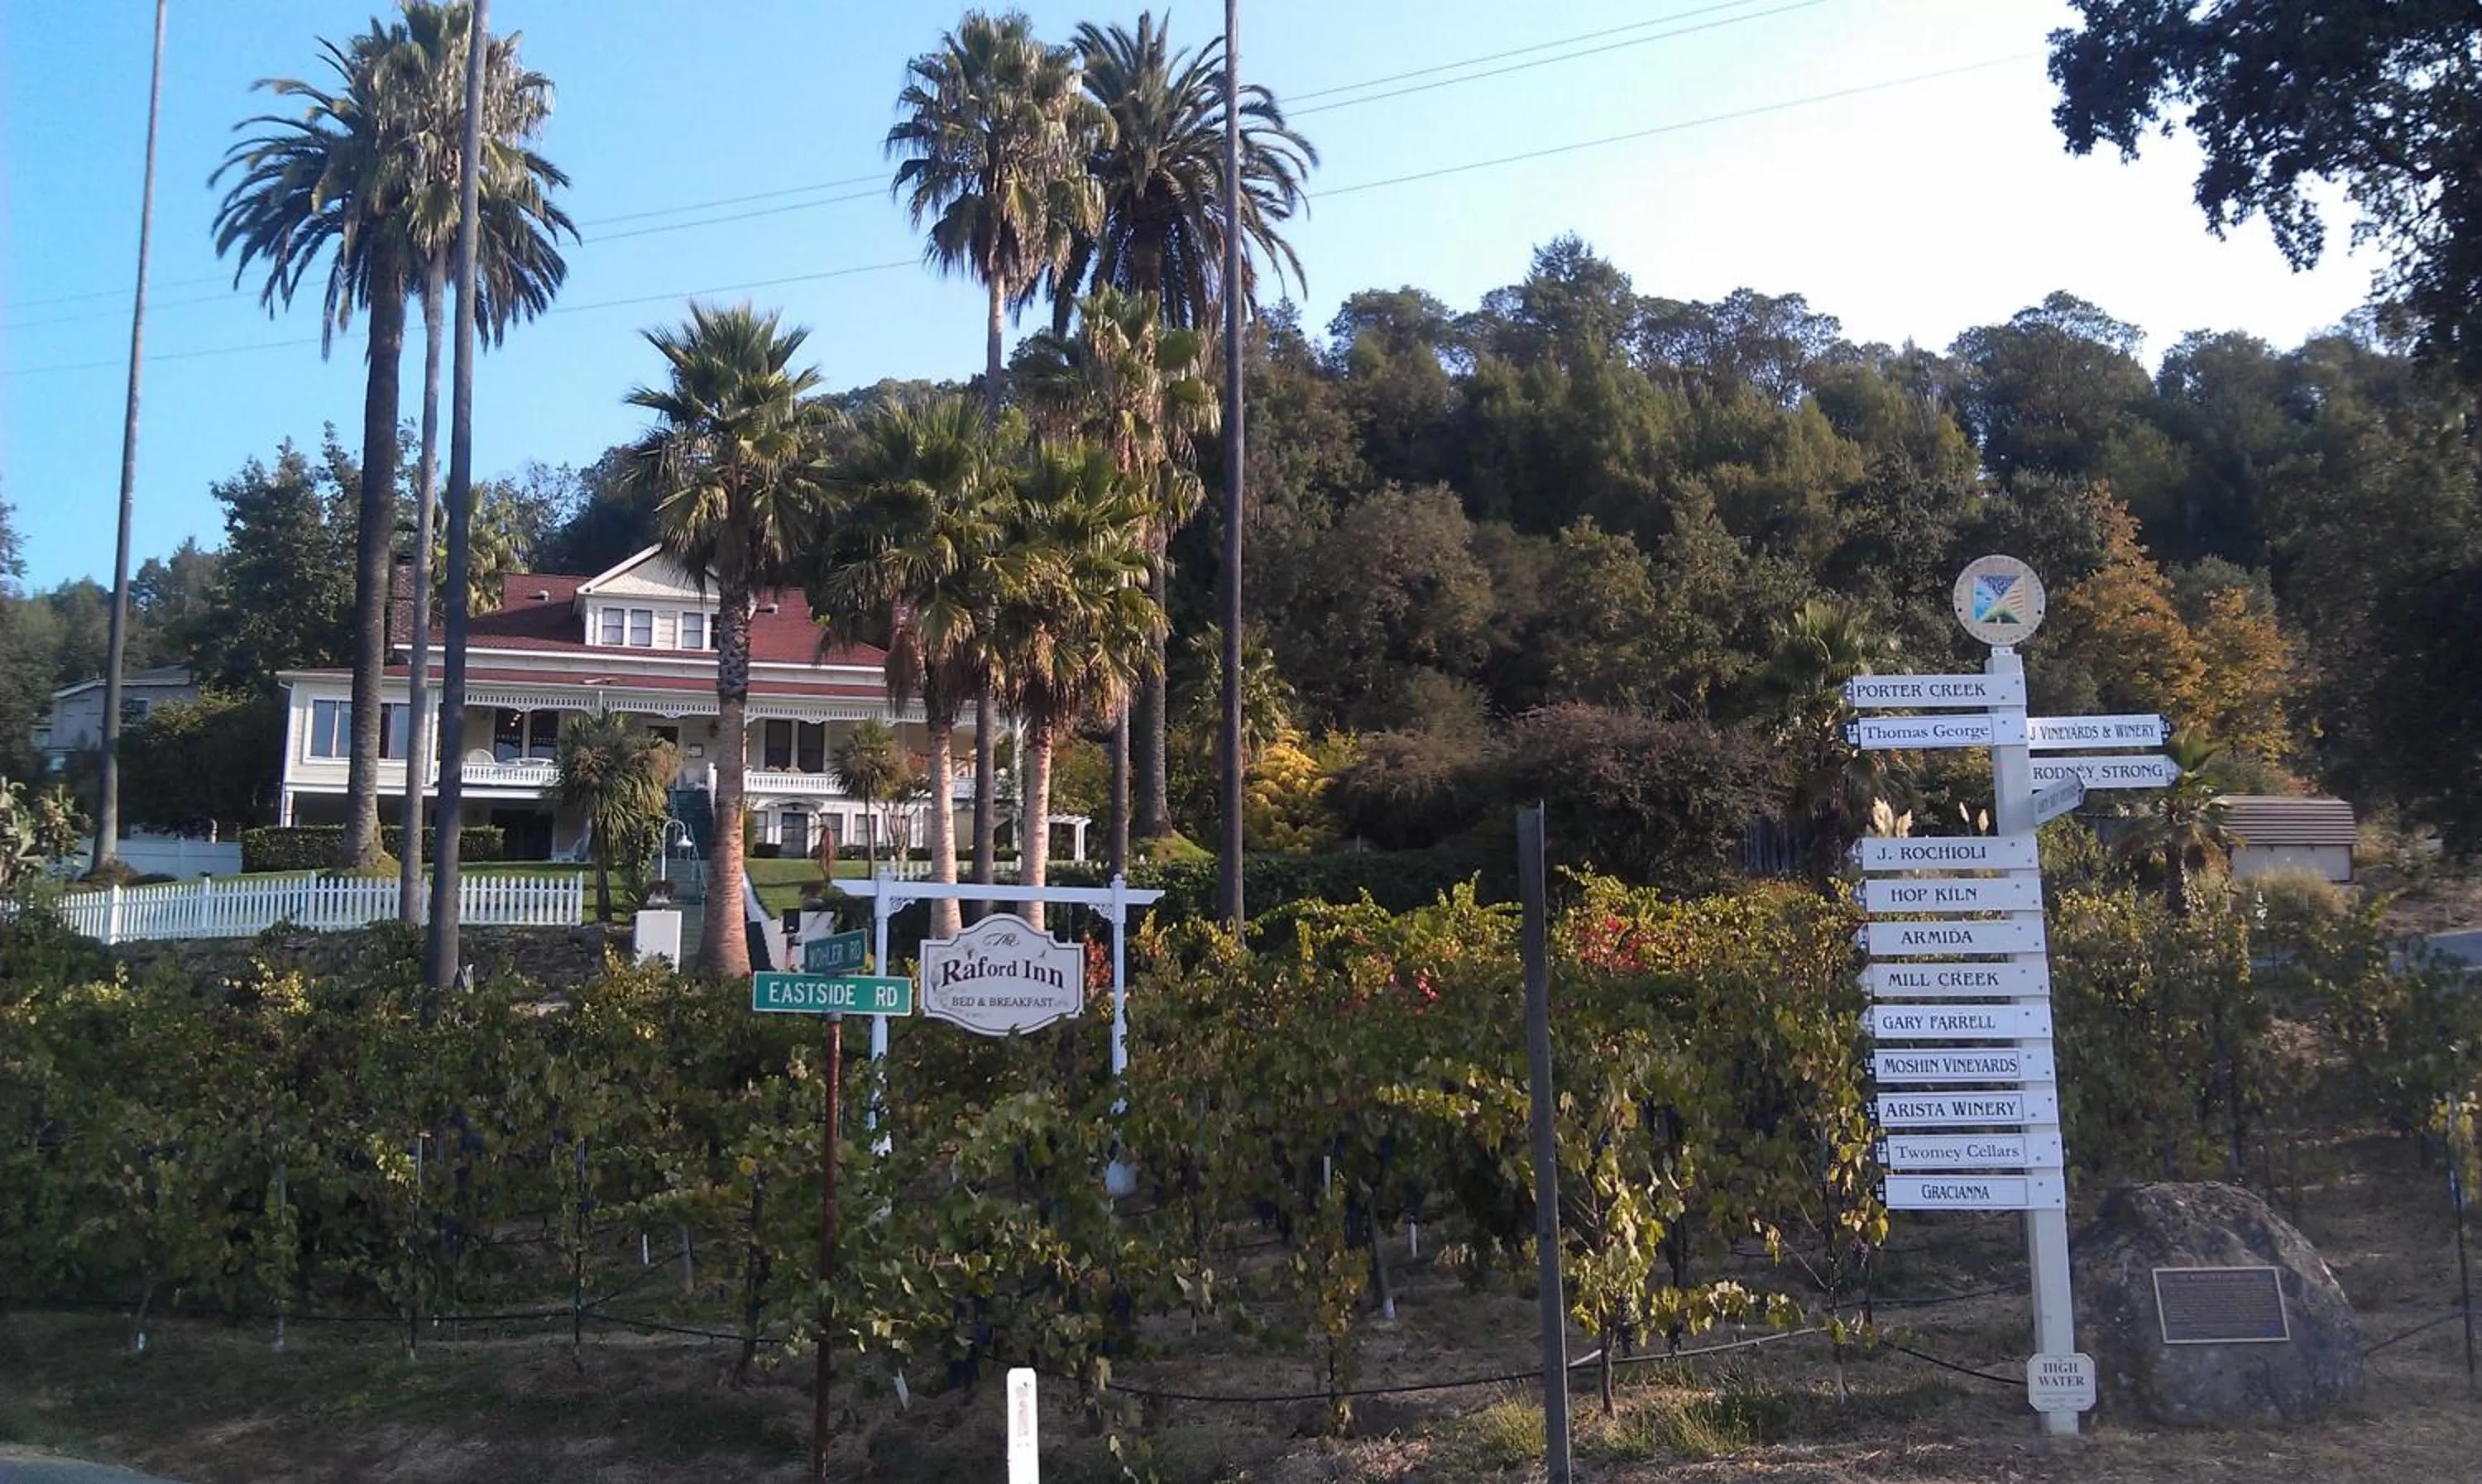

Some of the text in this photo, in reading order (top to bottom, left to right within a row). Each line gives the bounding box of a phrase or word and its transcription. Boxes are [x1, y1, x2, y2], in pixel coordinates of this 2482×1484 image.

[1857, 684, 1922, 697] PORTER
[1929, 683, 1986, 698] CREEK
[1863, 726, 1928, 740] Thomas
[1933, 725, 1990, 740] George
[2029, 726, 2036, 740] J
[2039, 725, 2099, 740] VINEYARDS
[2102, 726, 2111, 738] &
[2115, 724, 2155, 738] WINERY
[2101, 764, 2163, 778] STRONG
[1876, 847, 1892, 860] J.
[1900, 846, 1986, 859] ROCHIOLI
[1891, 888, 1977, 902] HOP KILN
[983, 933, 1020, 947] The
[1901, 931, 1973, 945] ARMIDA
[850, 939, 861, 960] RD
[941, 956, 1064, 989] Raford Inn
[1888, 972, 1999, 987] MILL CREEK
[769, 981, 898, 1007] EASTSIDE RD
[951, 997, 1055, 1008] BED & BREAKFAST
[1882, 1015, 1996, 1030] GARY FARRELL
[1884, 1059, 1938, 1073] MOSHIN
[1943, 1058, 2018, 1073] VINEYARDS
[1885, 1103, 1945, 1117] ARISTA
[1952, 1101, 2016, 1116] WINERY
[1895, 1146, 1962, 1161] Twomey
[1967, 1144, 2020, 1158] Cellars
[1922, 1185, 1990, 1199] GRACIANNA
[2043, 1362, 2078, 1373] HIGH
[2038, 1376, 2085, 1386] WATER
